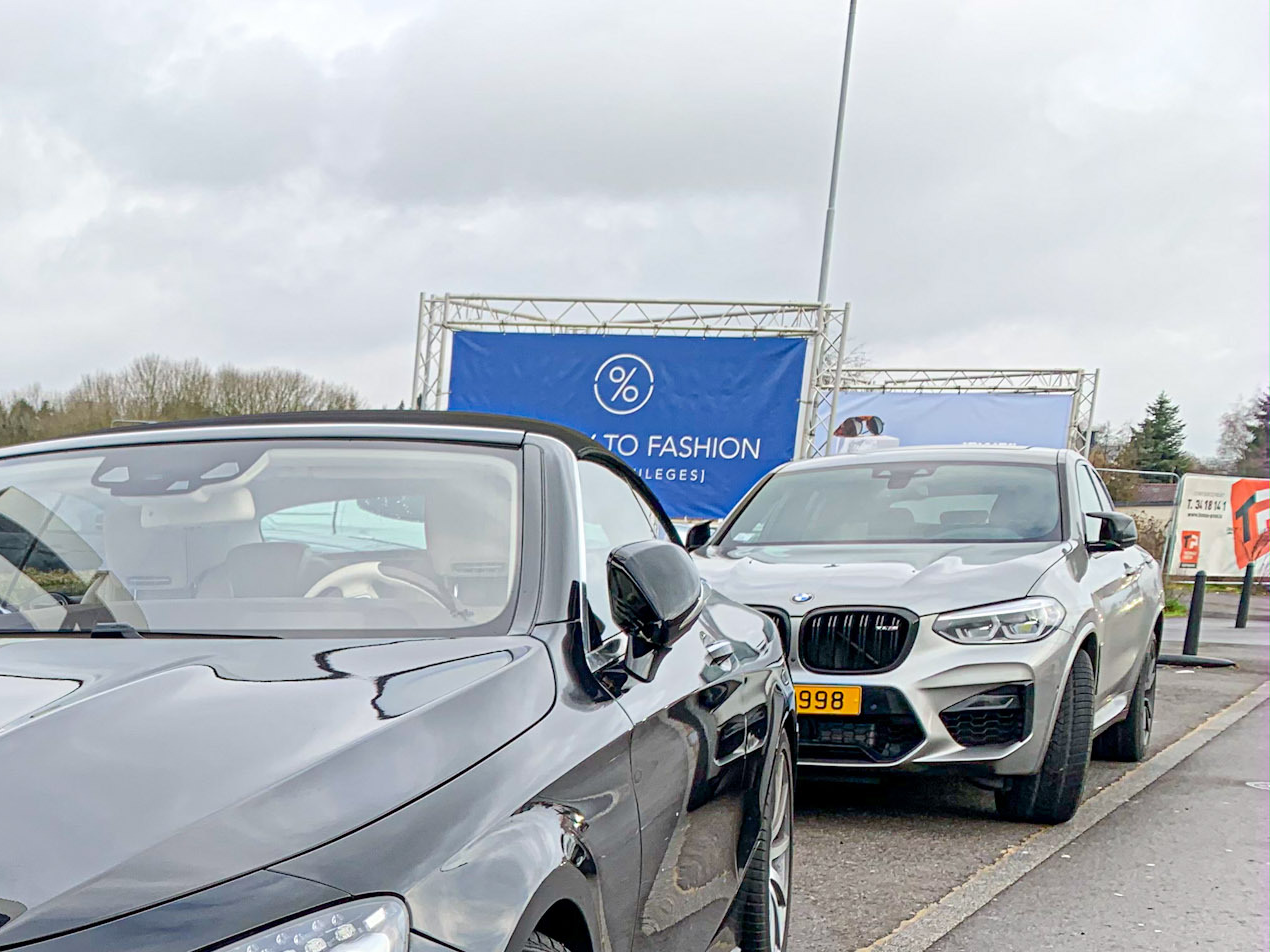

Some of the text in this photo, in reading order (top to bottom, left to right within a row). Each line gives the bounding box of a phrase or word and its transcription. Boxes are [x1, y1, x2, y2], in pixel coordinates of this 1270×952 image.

[603, 434, 761, 459] TO FASHION
[799, 690, 844, 710] 998
